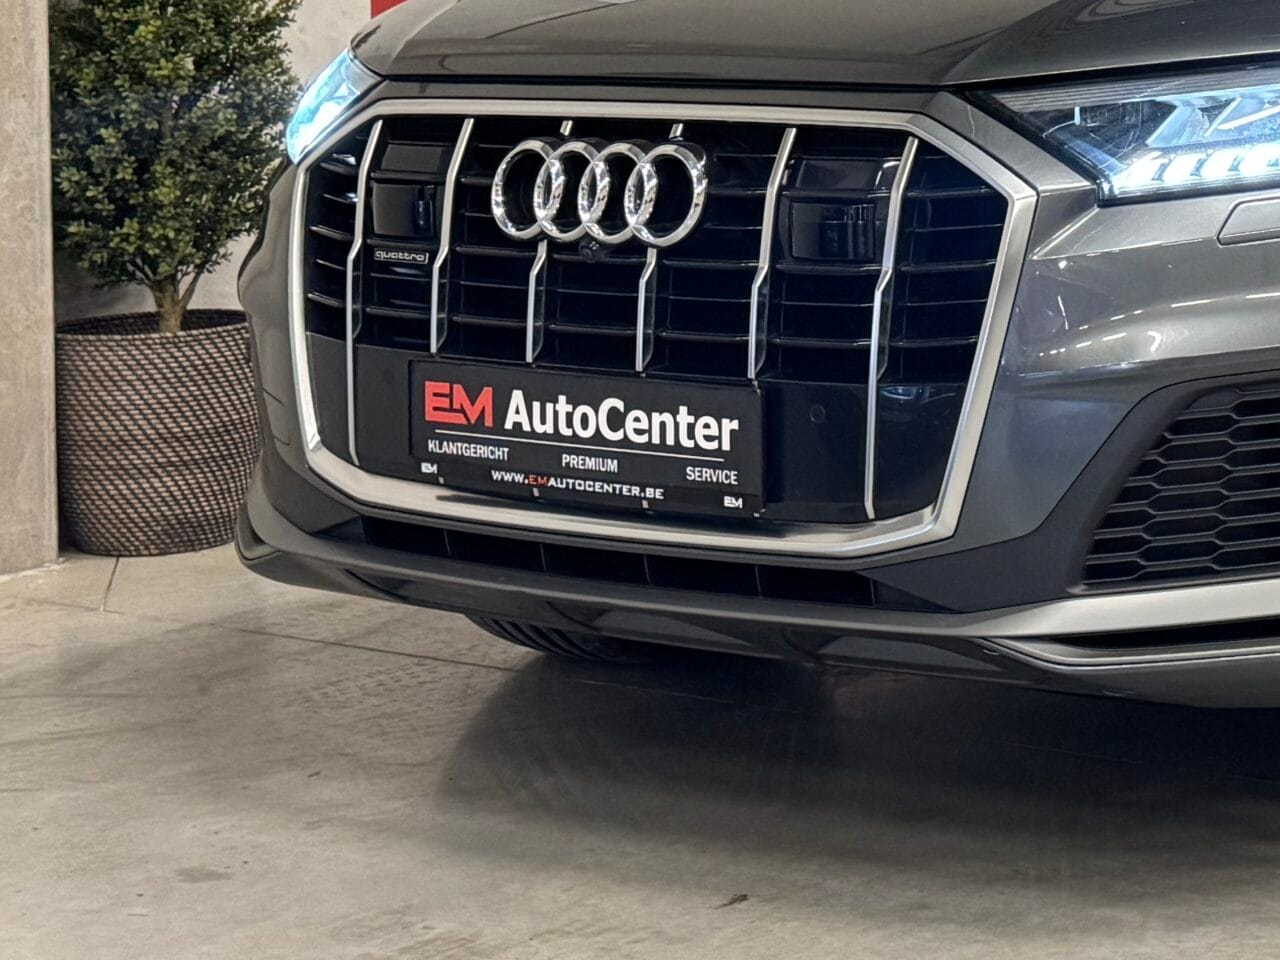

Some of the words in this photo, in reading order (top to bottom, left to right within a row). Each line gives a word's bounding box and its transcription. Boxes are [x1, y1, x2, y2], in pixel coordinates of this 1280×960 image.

[375, 250, 425, 261] quattro
[424, 380, 494, 427] EM
[504, 389, 739, 452] AutoCenter
[427, 439, 510, 461] KLANTGERICHT
[561, 453, 618, 473] PREMIUM
[685, 466, 739, 485] SERVICE
[491, 469, 665, 500] WWW.EMAUTOCENTER.BE
